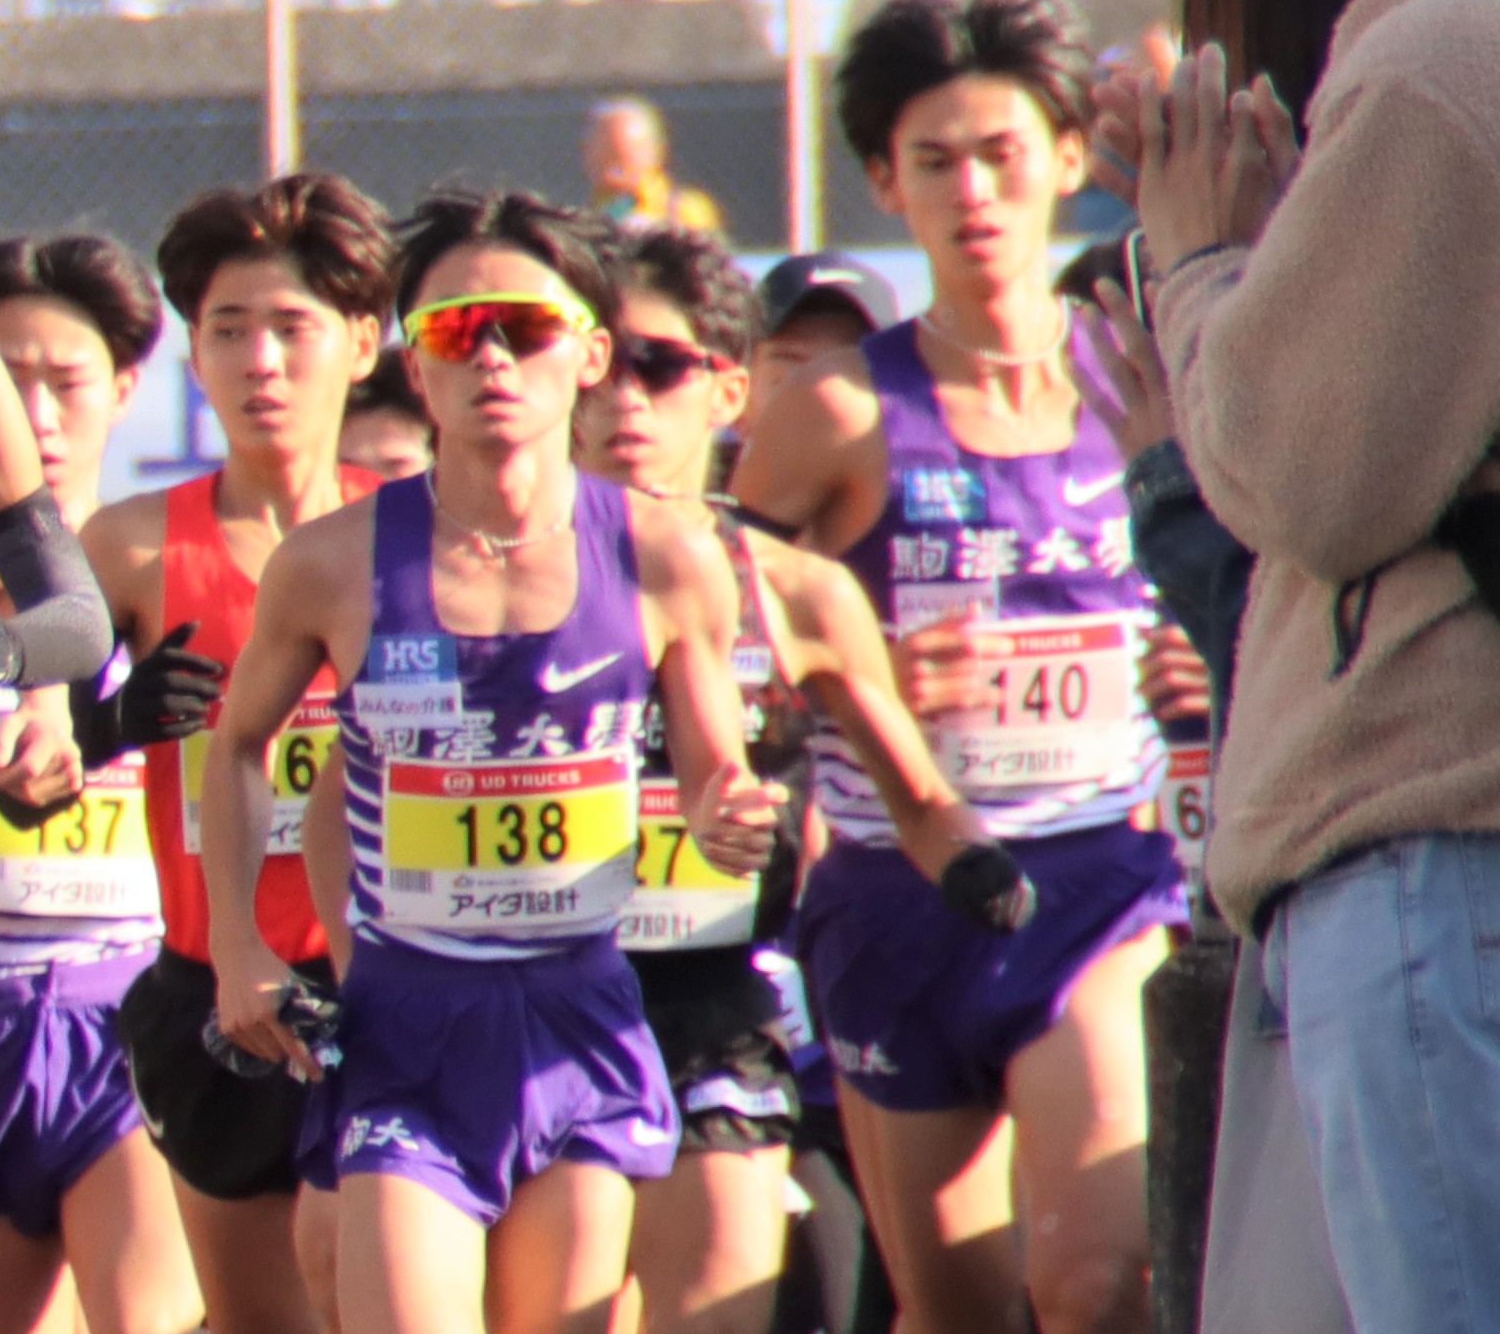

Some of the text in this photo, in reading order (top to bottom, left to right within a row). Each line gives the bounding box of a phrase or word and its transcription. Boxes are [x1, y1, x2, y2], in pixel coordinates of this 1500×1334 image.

[384, 639, 439, 670] HRS
[1018, 633, 1081, 649] TRUCKS
[988, 662, 1090, 727] 140
[481, 776, 506, 789] UD
[512, 769, 581, 787] TRUCKS
[457, 801, 568, 867] 138
[451, 887, 580, 917] アイダ設計
